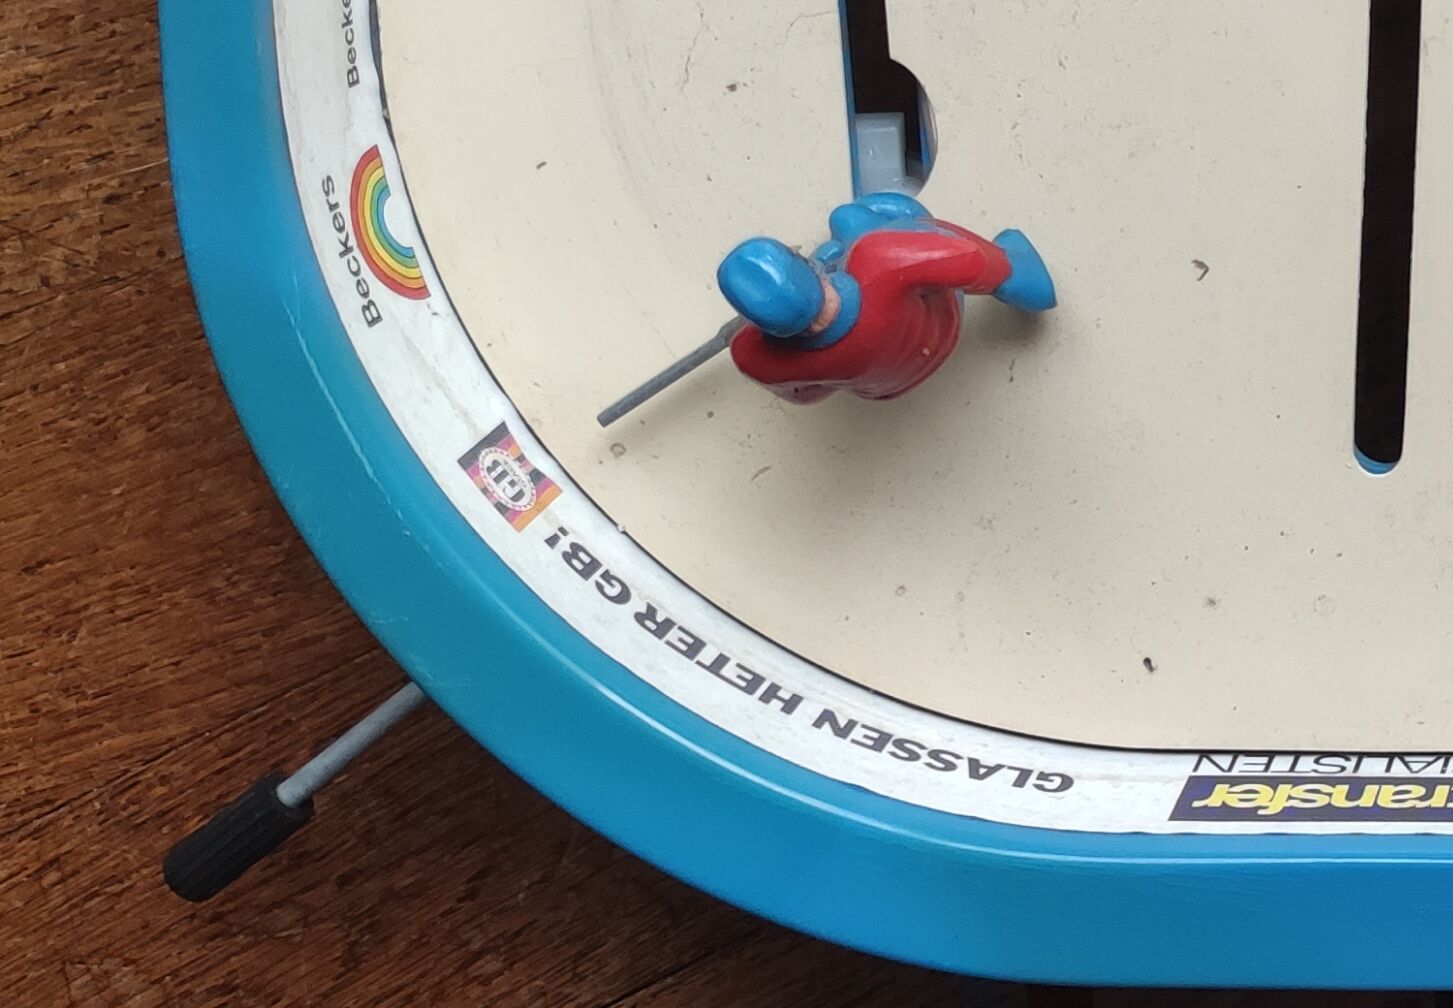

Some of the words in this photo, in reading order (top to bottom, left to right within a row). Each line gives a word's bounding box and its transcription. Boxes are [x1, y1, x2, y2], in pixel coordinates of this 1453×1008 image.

[322, 175, 383, 327] Beckers
[545, 526, 633, 604] GB!
[635, 602, 804, 716] HETER
[812, 709, 1076, 797] GLASSEN
